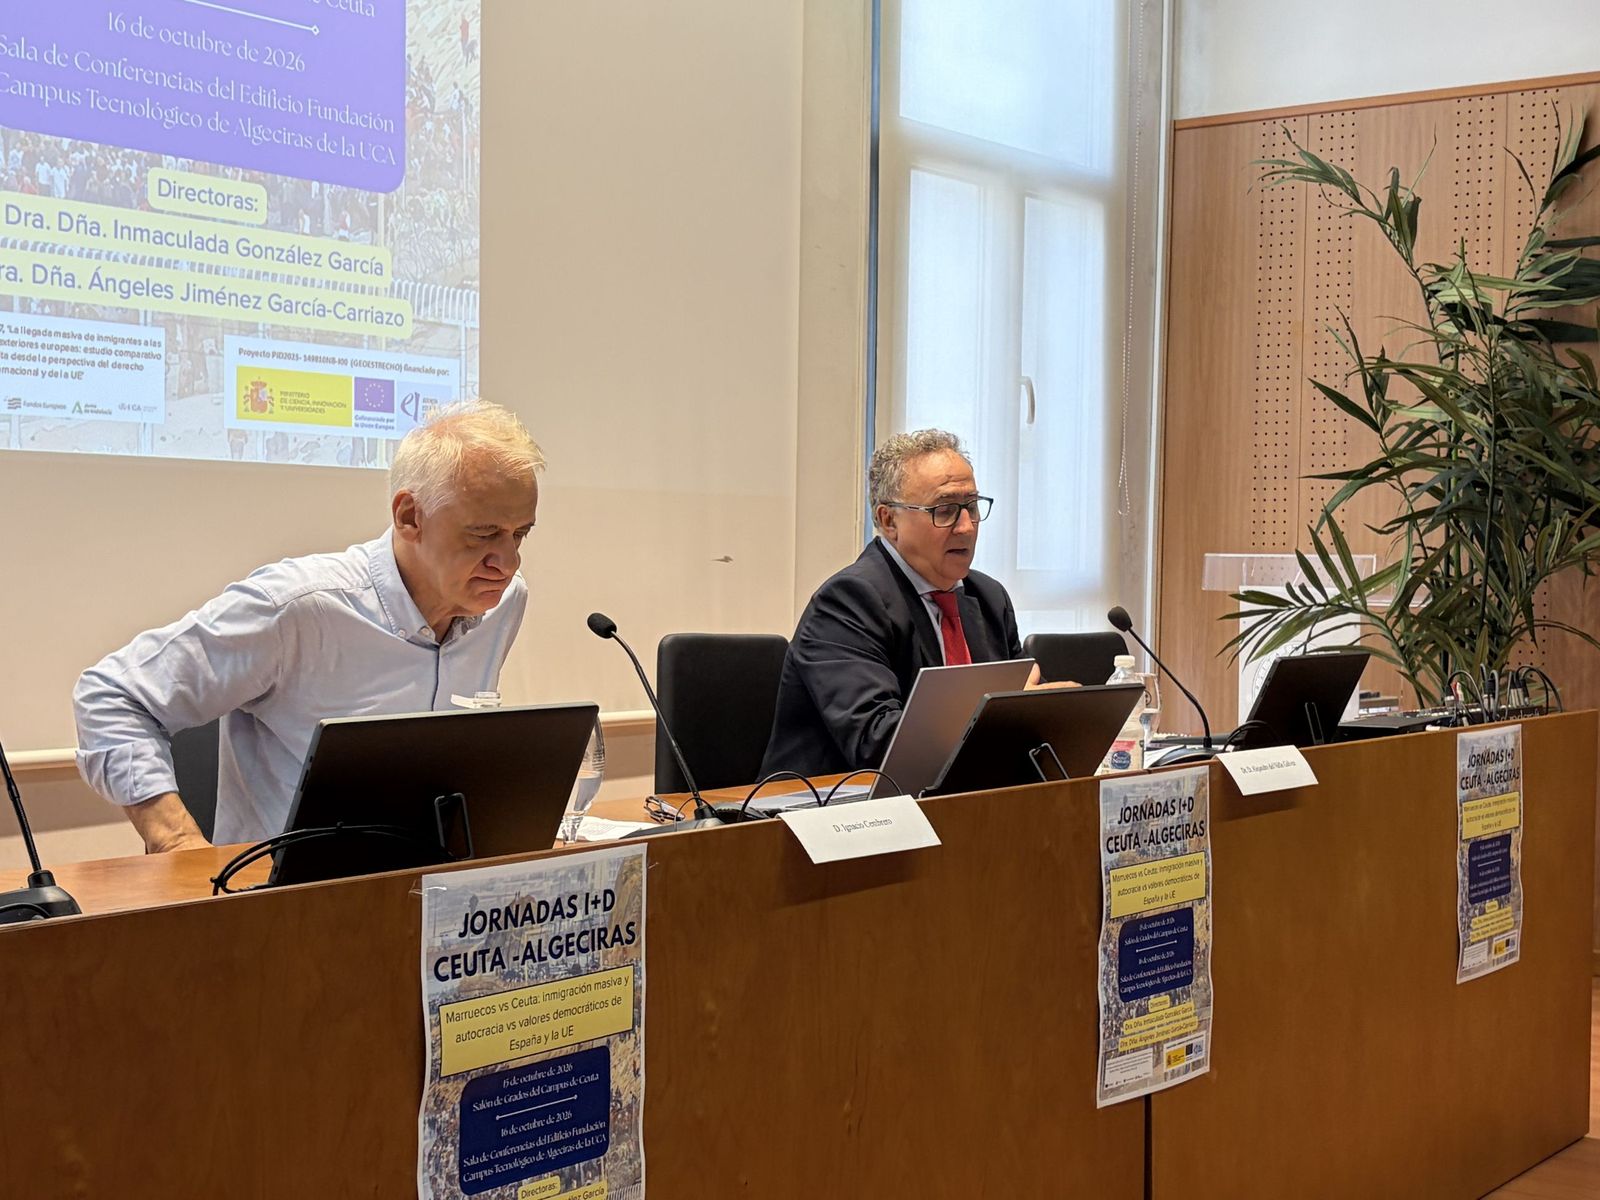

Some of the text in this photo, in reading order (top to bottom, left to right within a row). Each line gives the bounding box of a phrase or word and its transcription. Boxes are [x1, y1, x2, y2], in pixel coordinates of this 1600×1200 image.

[108, 12, 305, 72] 16 de octubre de 2026
[0, 35, 394, 133] Sala de Conferencias del Edificio Fundación
[0, 72, 396, 165] Campus Tecnológico de Algeciras de la UCA
[158, 178, 259, 212] Directoras:
[5, 204, 384, 276] Dra. Dña. Inmaculada González García
[32, 264, 82, 290] Dña.
[88, 266, 174, 300] Ángeles
[180, 283, 262, 310] Jiménez
[268, 293, 405, 327] García-Carriazo
[20, 326, 52, 338] llegada
[53, 331, 82, 340] masiva
[84, 333, 95, 341] de
[97, 333, 142, 345] inmigrantes
[150, 338, 162, 348] las
[10, 352, 37, 362] desde
[38, 354, 47, 363] la
[48, 356, 96, 367] perspectiva
[97, 360, 109, 368] del
[111, 361, 144, 371] derecho
[83, 346, 113, 356] estudio
[114, 349, 162, 360] comparativo
[239, 347, 271, 358] Proyecto
[41, 370, 47, 379] y
[48, 369, 59, 378] de
[1468, 750, 1504, 768] JORNADAS
[1461, 775, 1481, 790] CEUTA
[1118, 797, 1194, 824] JORNADAS I+D
[833, 824, 842, 833] D.
[841, 822, 864, 833] Ignacio
[1106, 832, 1140, 854] CEUTA
[458, 888, 616, 938] JORNADAS I+D
[434, 921, 637, 982] CEUTA -ALGECIRAS
[446, 975, 630, 1024] Marruecos vs Ceuta: inmigración masiva y
[455, 995, 623, 1044] autocracia vs valores democráticos de
[509, 1024, 574, 1051] España y la UE
[510, 1074, 519, 1086] de
[547, 1066, 556, 1076] de
[494, 1096, 503, 1106] de
[530, 1086, 540, 1097] del
[541, 1080, 569, 1094] Campus
[570, 1076, 579, 1086] de
[509, 1124, 518, 1134] de
[546, 1114, 555, 1124] de
[463, 1167, 493, 1182] Campus
[536, 1151, 545, 1161] de
[575, 1139, 584, 1150] de
[480, 1151, 489, 1161] de
[521, 1182, 557, 1199] Directoras:
[583, 1186, 605, 1200] García
